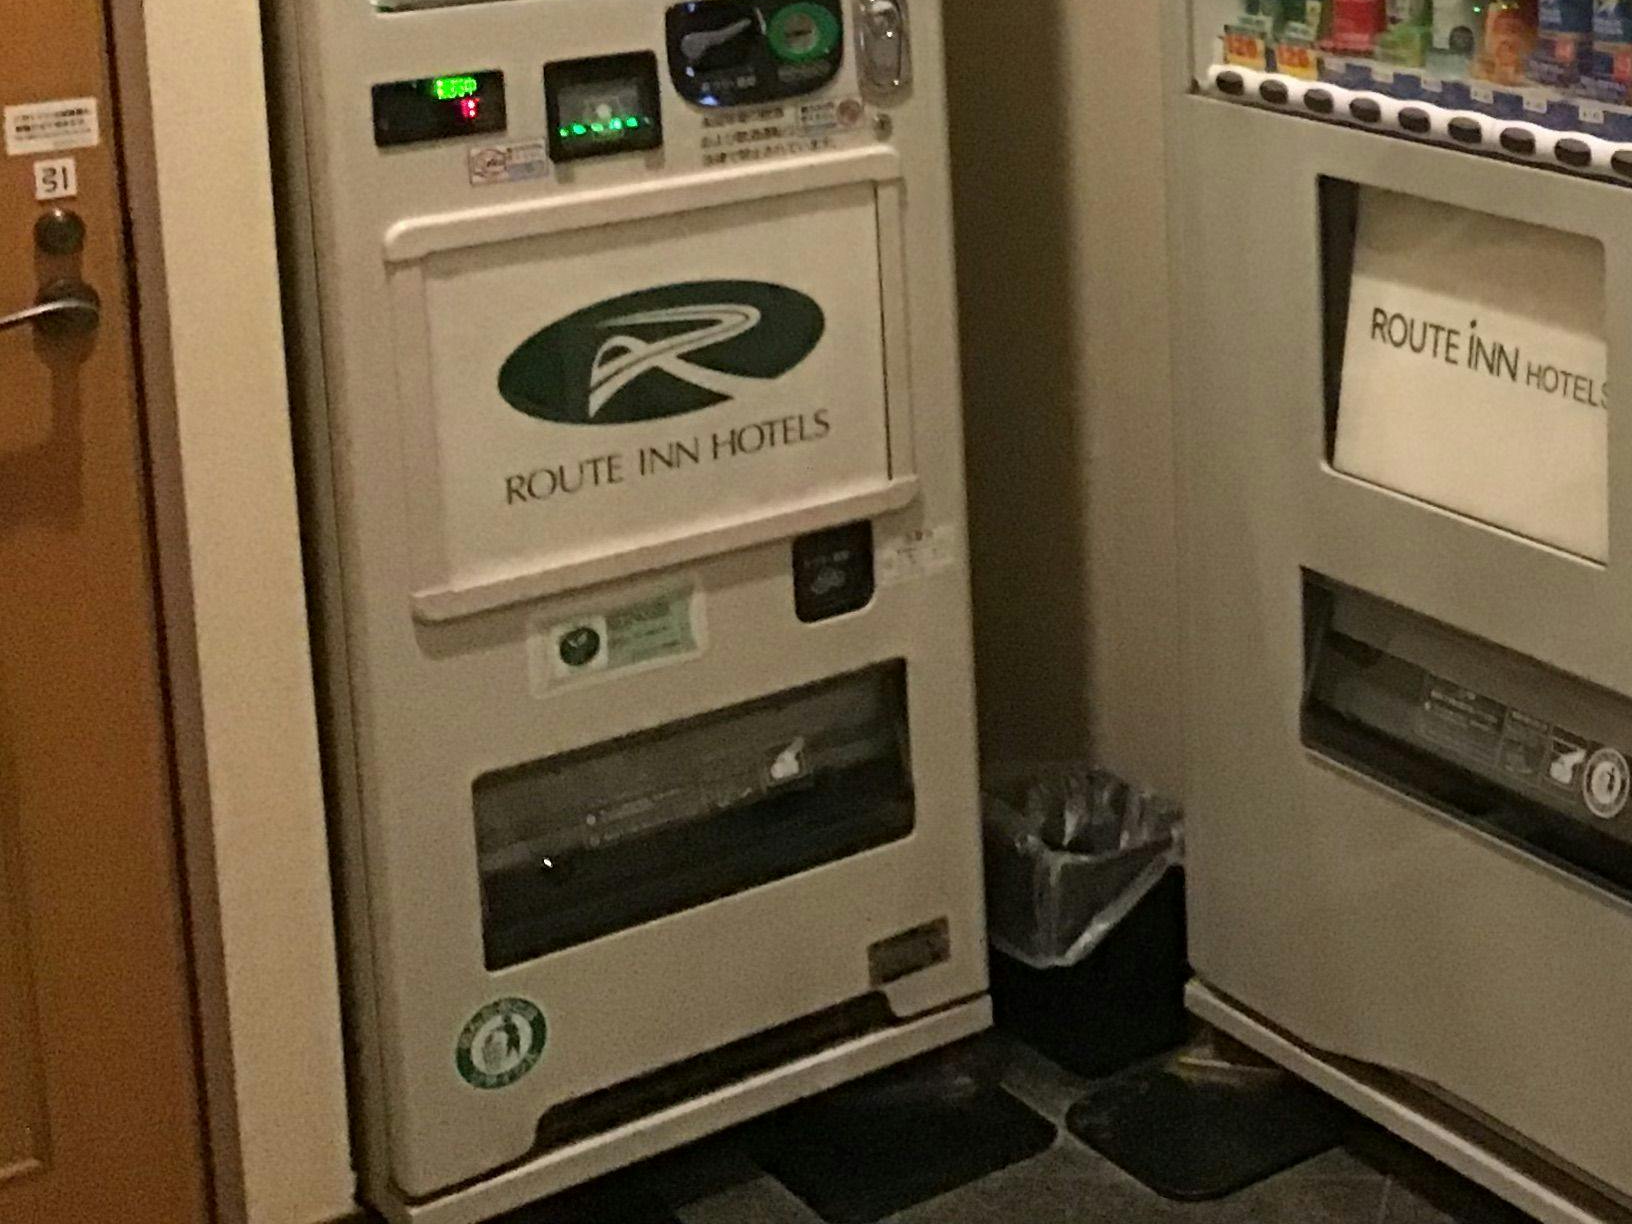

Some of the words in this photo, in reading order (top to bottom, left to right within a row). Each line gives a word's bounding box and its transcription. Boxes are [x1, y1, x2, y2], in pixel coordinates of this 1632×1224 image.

[1370, 306, 1462, 365] ROUTE
[504, 453, 626, 506] ROUTE
[639, 436, 701, 480] INN
[711, 409, 831, 462] HOTELS
